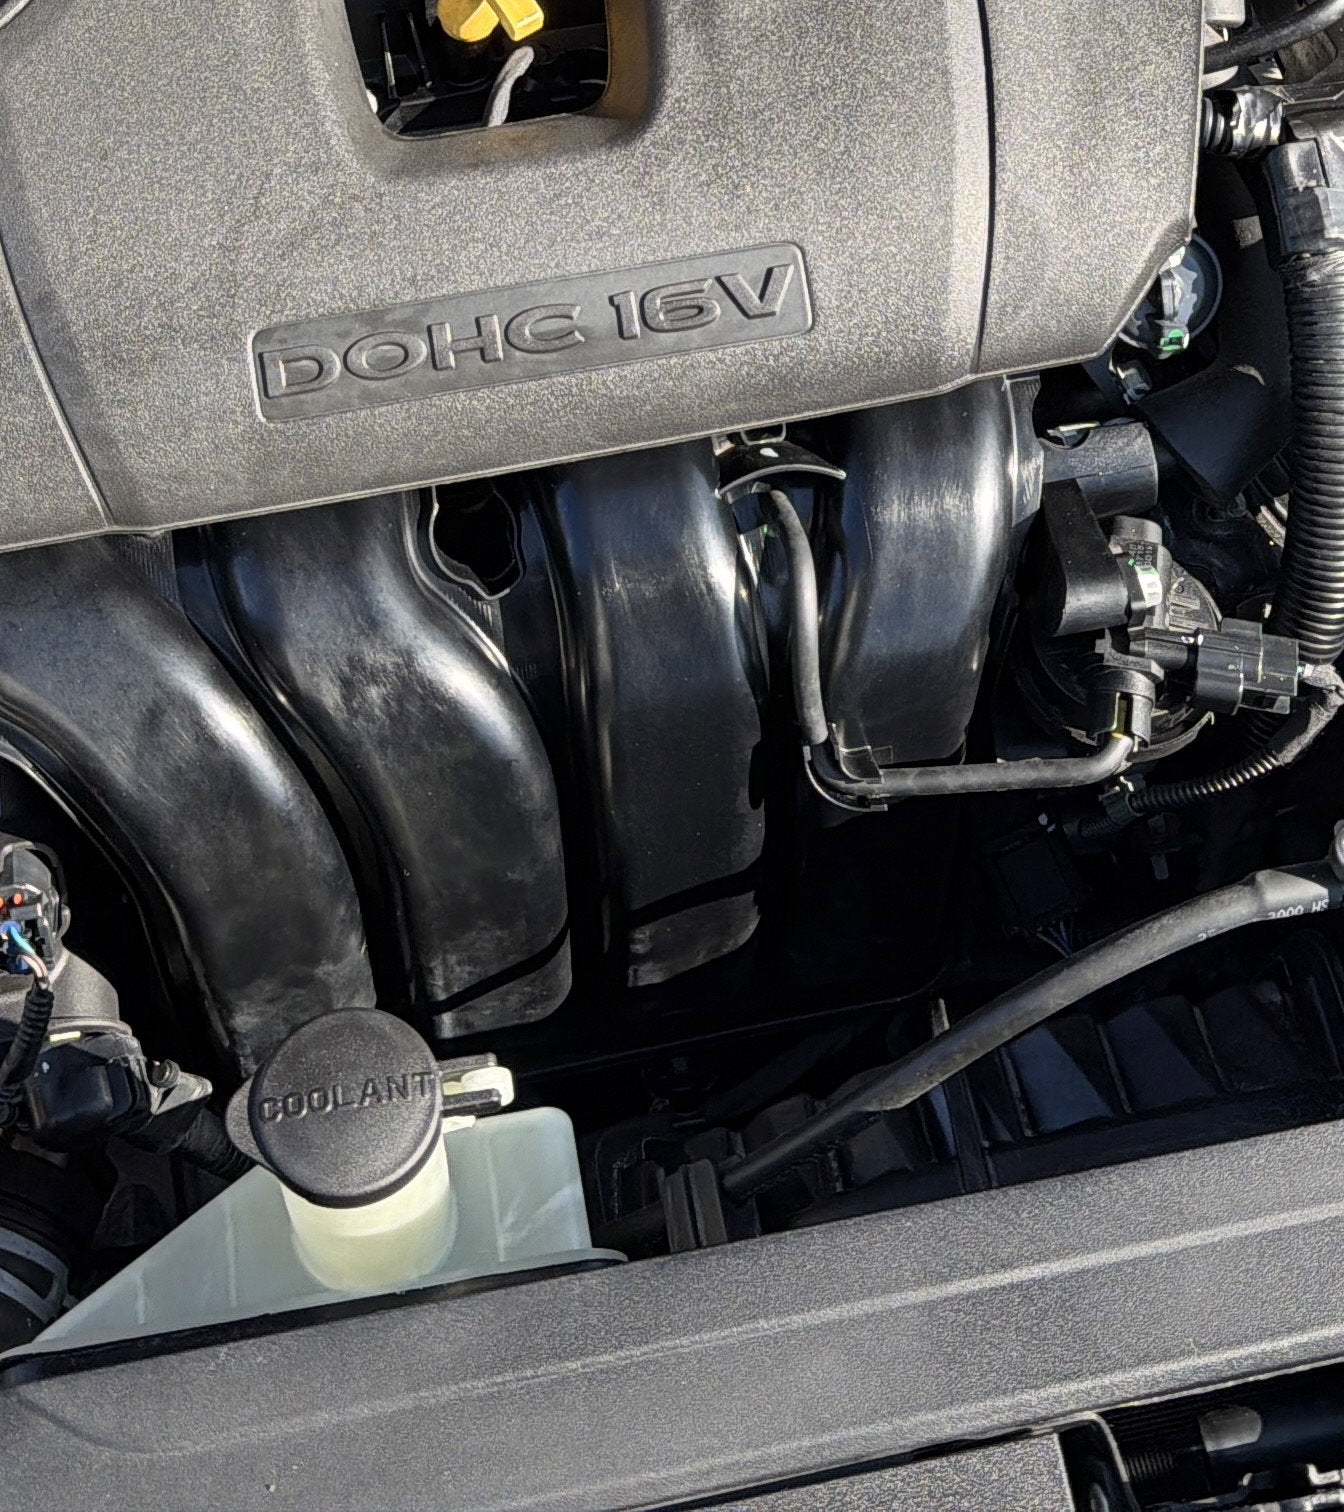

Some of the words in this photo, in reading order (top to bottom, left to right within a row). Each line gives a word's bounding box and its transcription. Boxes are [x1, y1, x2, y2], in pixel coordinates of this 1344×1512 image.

[259, 303, 587, 400] DOHC
[608, 263, 796, 341] 16V
[259, 1071, 435, 1123] COOLANT
